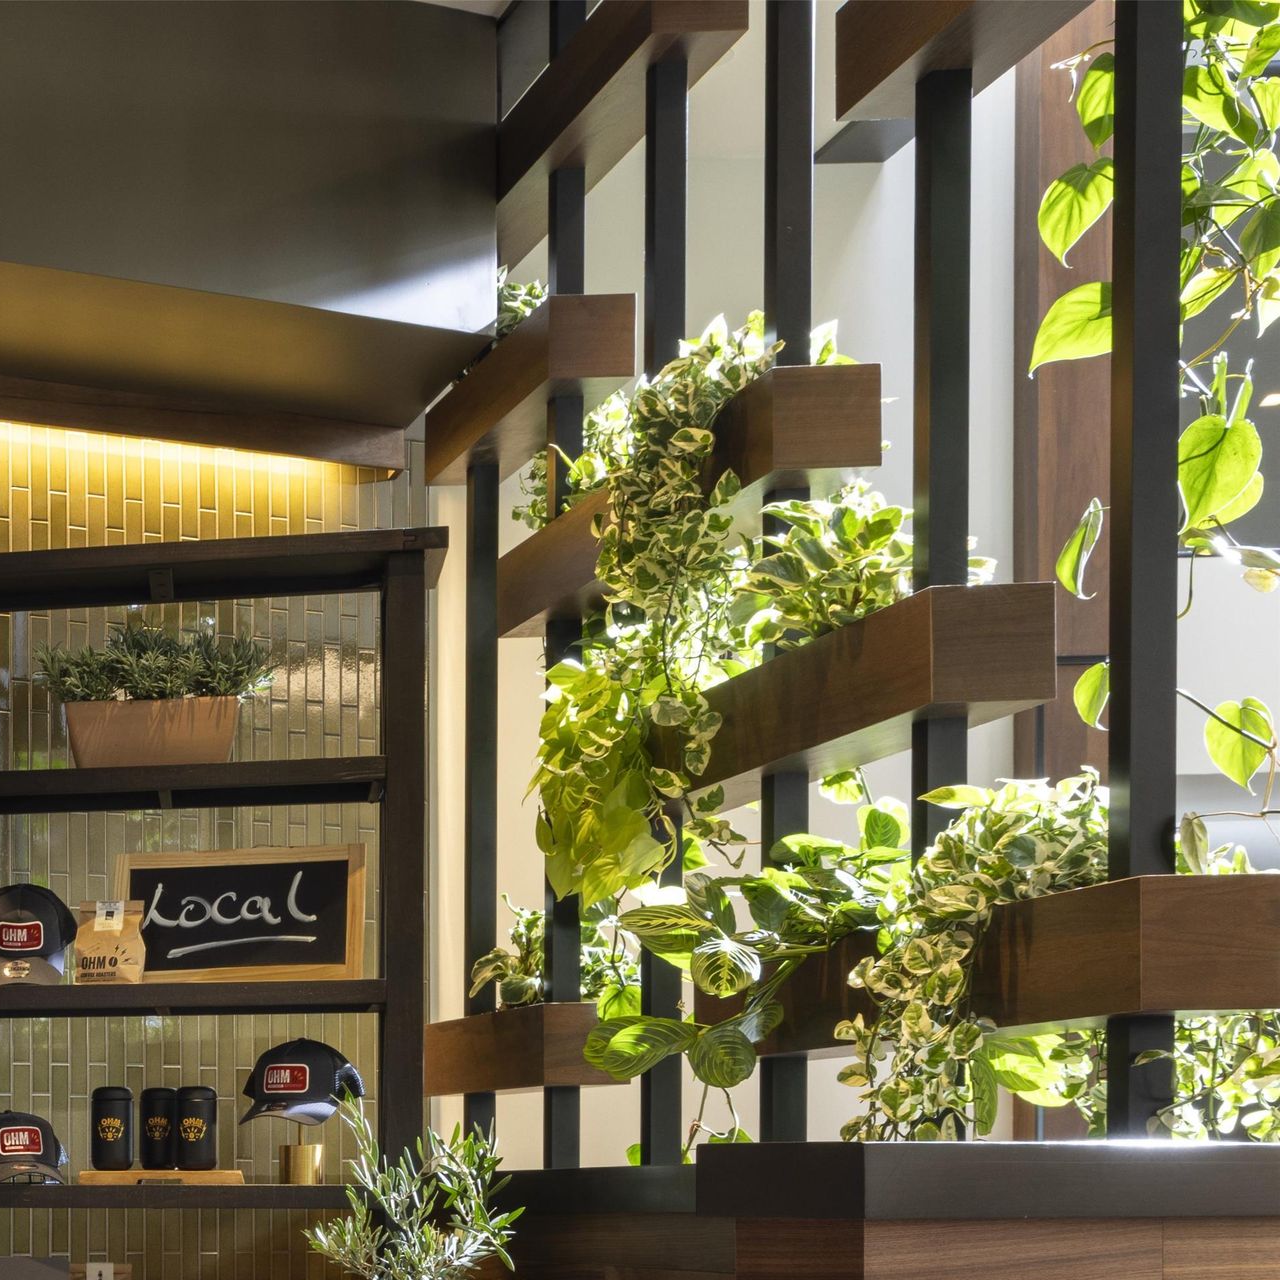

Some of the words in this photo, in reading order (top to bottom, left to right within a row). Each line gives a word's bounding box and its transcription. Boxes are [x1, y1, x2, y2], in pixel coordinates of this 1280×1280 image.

[143, 870, 317, 931] Local
[2, 928, 27, 942] OHM
[81, 956, 106, 970] OHM
[268, 1069, 290, 1083] OHM
[3, 1131, 29, 1146] OHM
